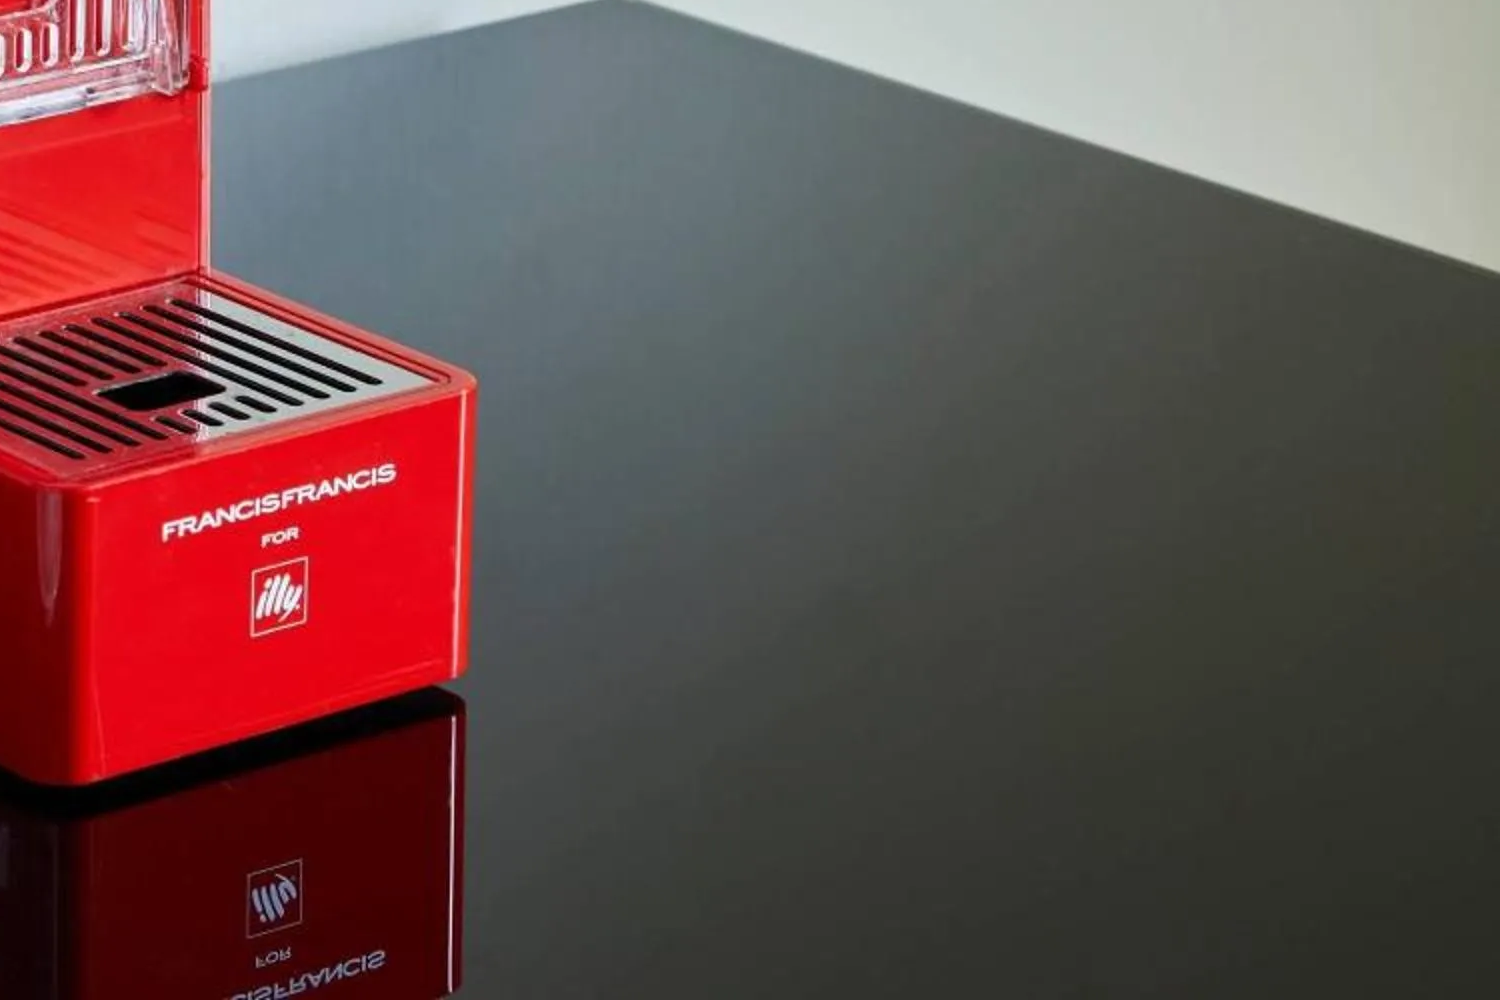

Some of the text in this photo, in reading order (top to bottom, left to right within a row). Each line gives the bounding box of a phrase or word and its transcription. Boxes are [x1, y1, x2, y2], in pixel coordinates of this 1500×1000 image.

[162, 463, 398, 543] FRANCISFRANCIS
[261, 527, 300, 549] FOR
[256, 573, 303, 622] illy
